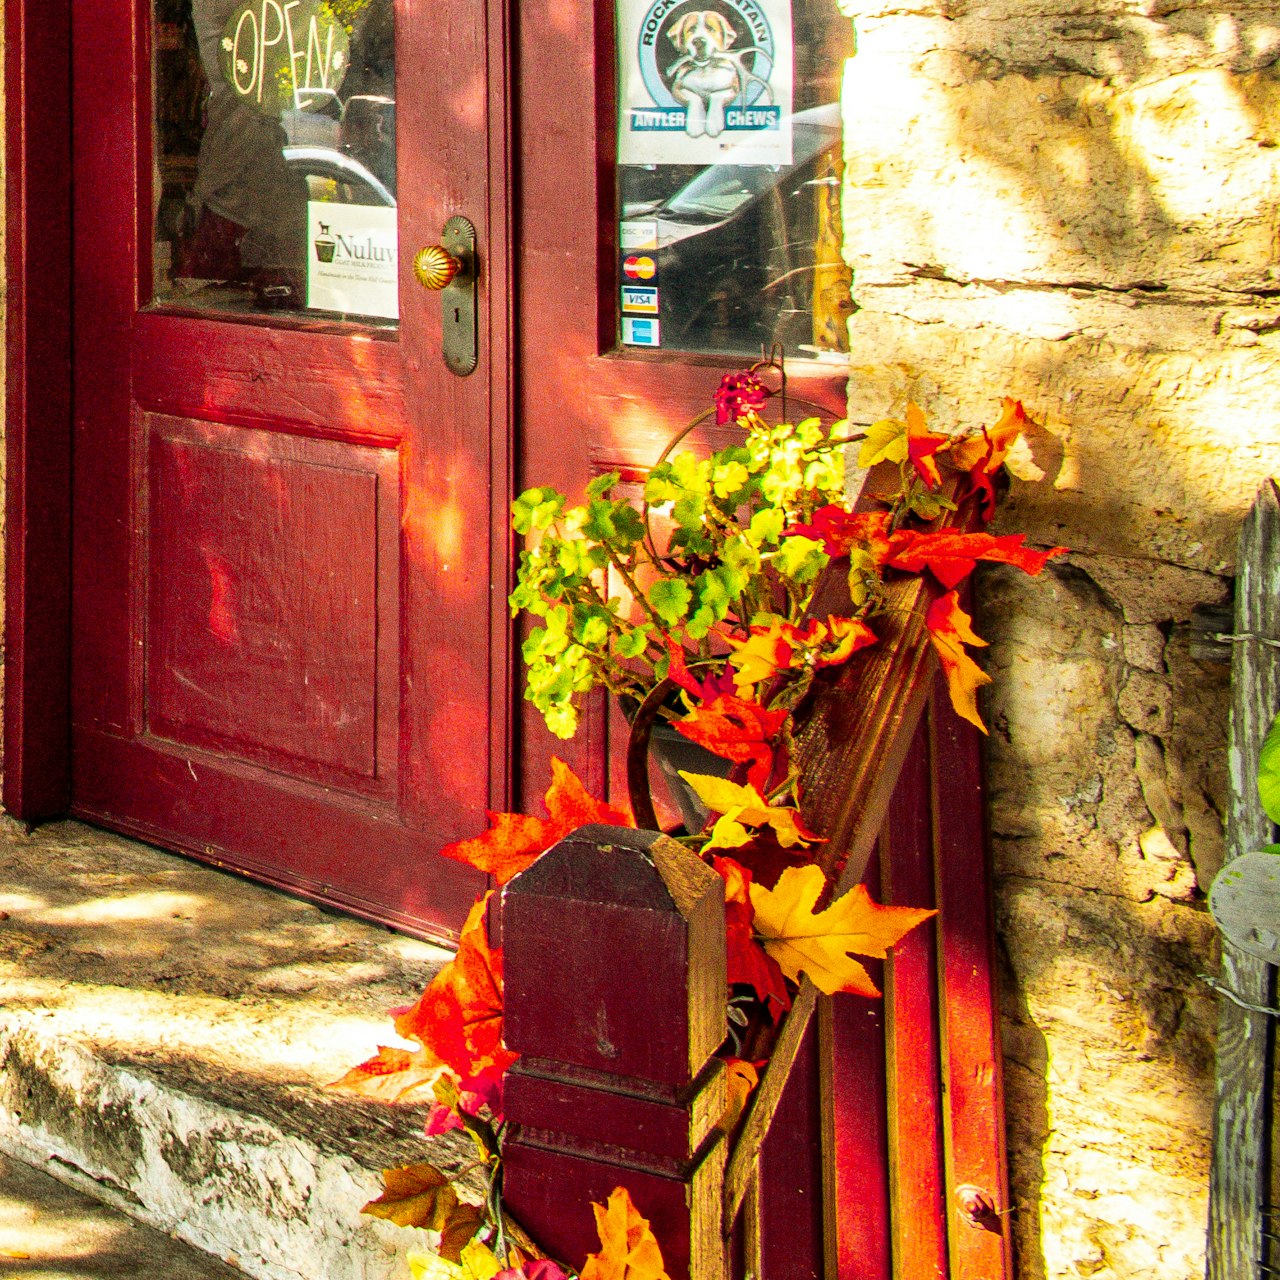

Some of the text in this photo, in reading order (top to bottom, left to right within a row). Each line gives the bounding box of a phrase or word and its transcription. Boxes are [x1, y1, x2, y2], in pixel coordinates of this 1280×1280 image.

[634, 110, 777, 128] ANTLER CHEWS
[628, 294, 652, 305] VISA
